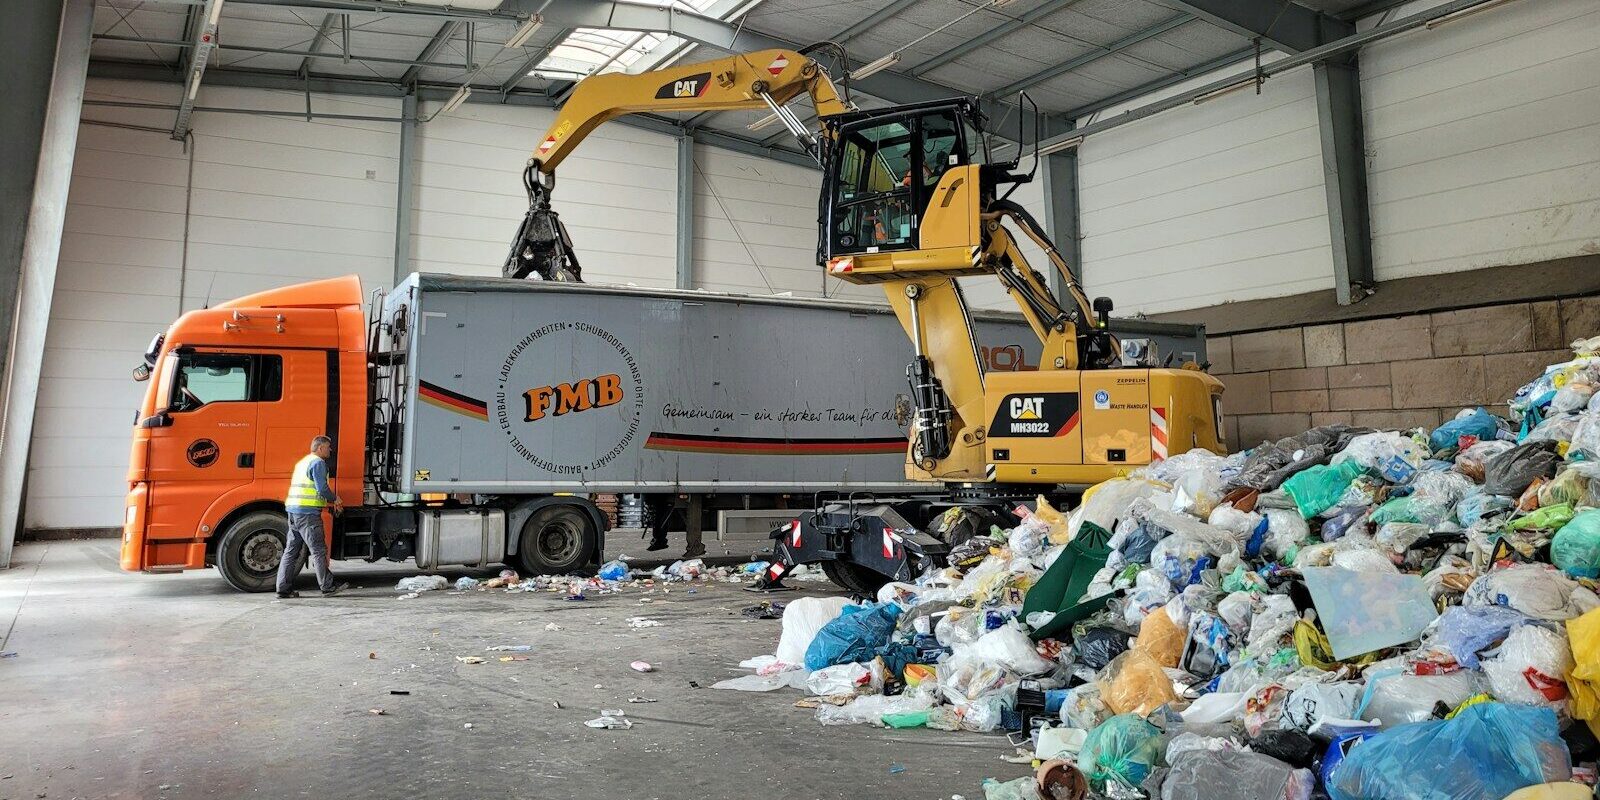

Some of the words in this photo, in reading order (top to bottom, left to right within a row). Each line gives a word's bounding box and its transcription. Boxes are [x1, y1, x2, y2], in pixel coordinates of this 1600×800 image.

[673, 80, 697, 97] CAT
[499, 321, 566, 382] LADEKRANARBEITEN
[574, 321, 644, 408] SCHUBBODENTRANSPORTE
[497, 391, 510, 430] ERDBAU
[522, 373, 624, 423] FMB
[662, 403, 735, 419] Gemeinsam
[754, 409, 771, 421] ein
[776, 408, 822, 422] starkes
[826, 408, 855, 423] Team
[860, 408, 878, 426] für
[1009, 397, 1044, 420] CAT
[1010, 423, 1049, 433] MH3022
[509, 435, 581, 474] BAUSTOFFHANDEL
